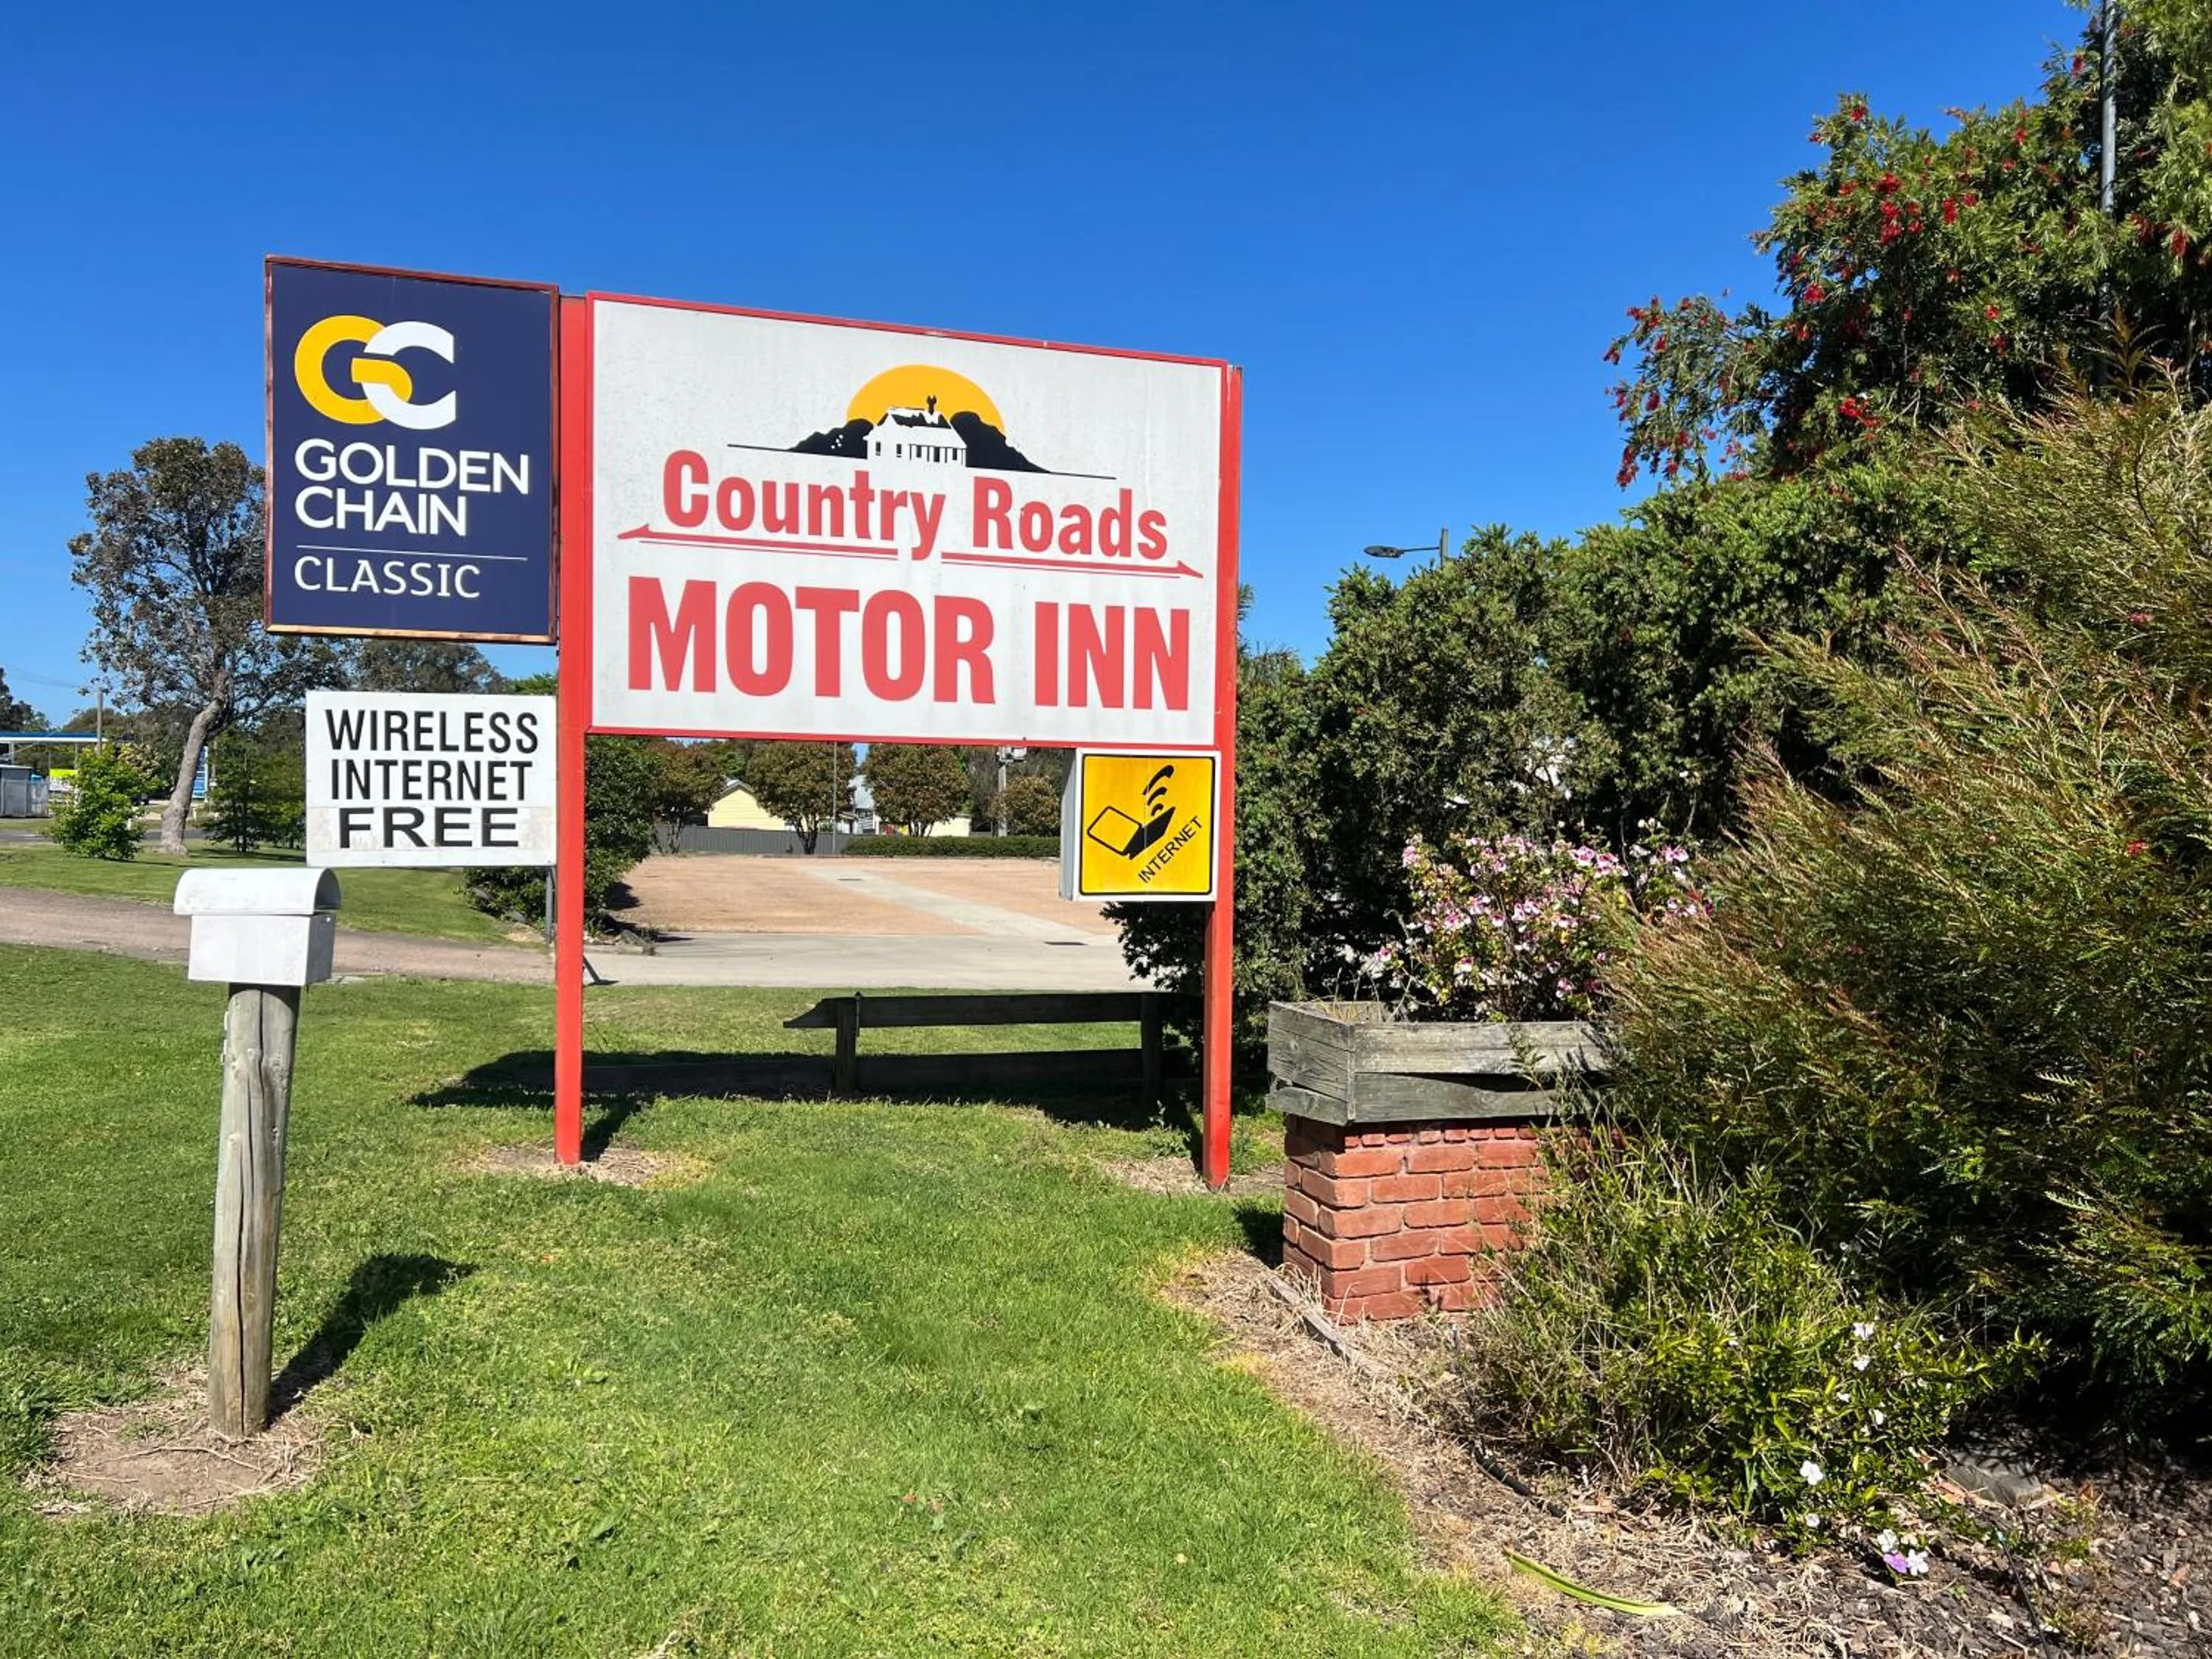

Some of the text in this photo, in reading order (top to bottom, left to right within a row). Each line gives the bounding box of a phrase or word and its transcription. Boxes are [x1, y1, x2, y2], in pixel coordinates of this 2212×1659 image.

[295, 439, 529, 495] GOLDEN
[295, 486, 467, 537] CHAIN
[662, 450, 1167, 562] Country Roads
[294, 556, 481, 599] CLASSIC
[627, 575, 1191, 712] MOTOR INN
[325, 709, 539, 754] WIRELESS
[331, 759, 533, 801] INTERNET
[338, 807, 519, 849] FREE
[1138, 815, 1203, 884] INTERNET
